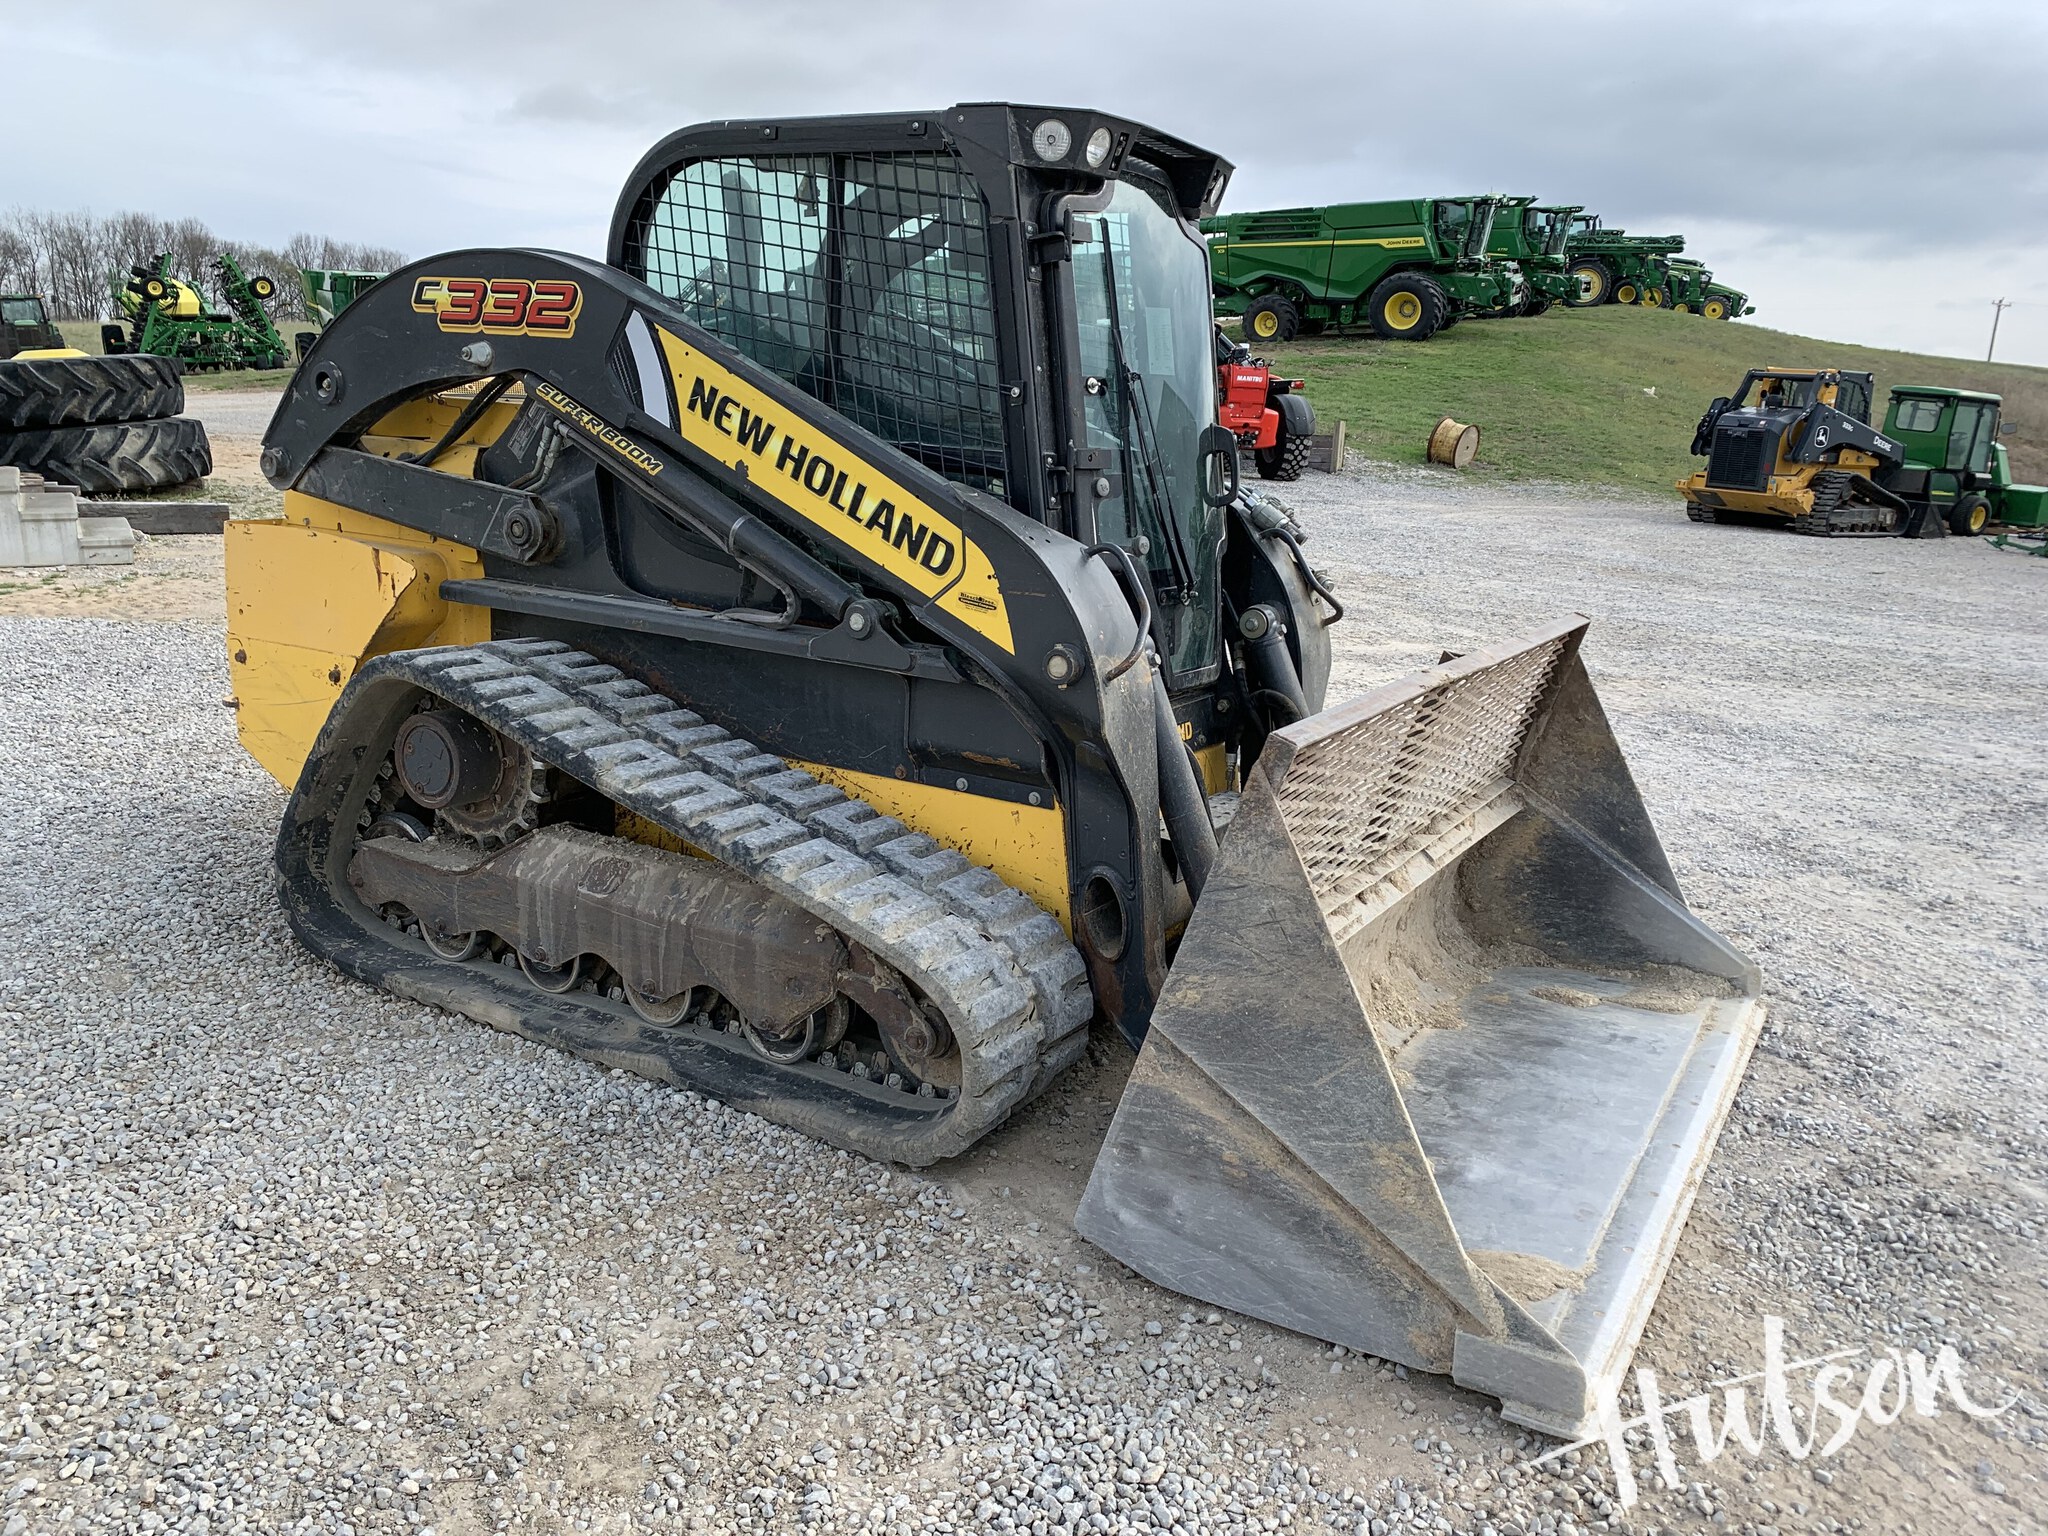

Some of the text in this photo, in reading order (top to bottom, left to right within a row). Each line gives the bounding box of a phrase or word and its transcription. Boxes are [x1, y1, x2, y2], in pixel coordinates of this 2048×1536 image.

[686, 376, 956, 577] NEW HOLLAND
[1873, 435, 1892, 452] DEERE
